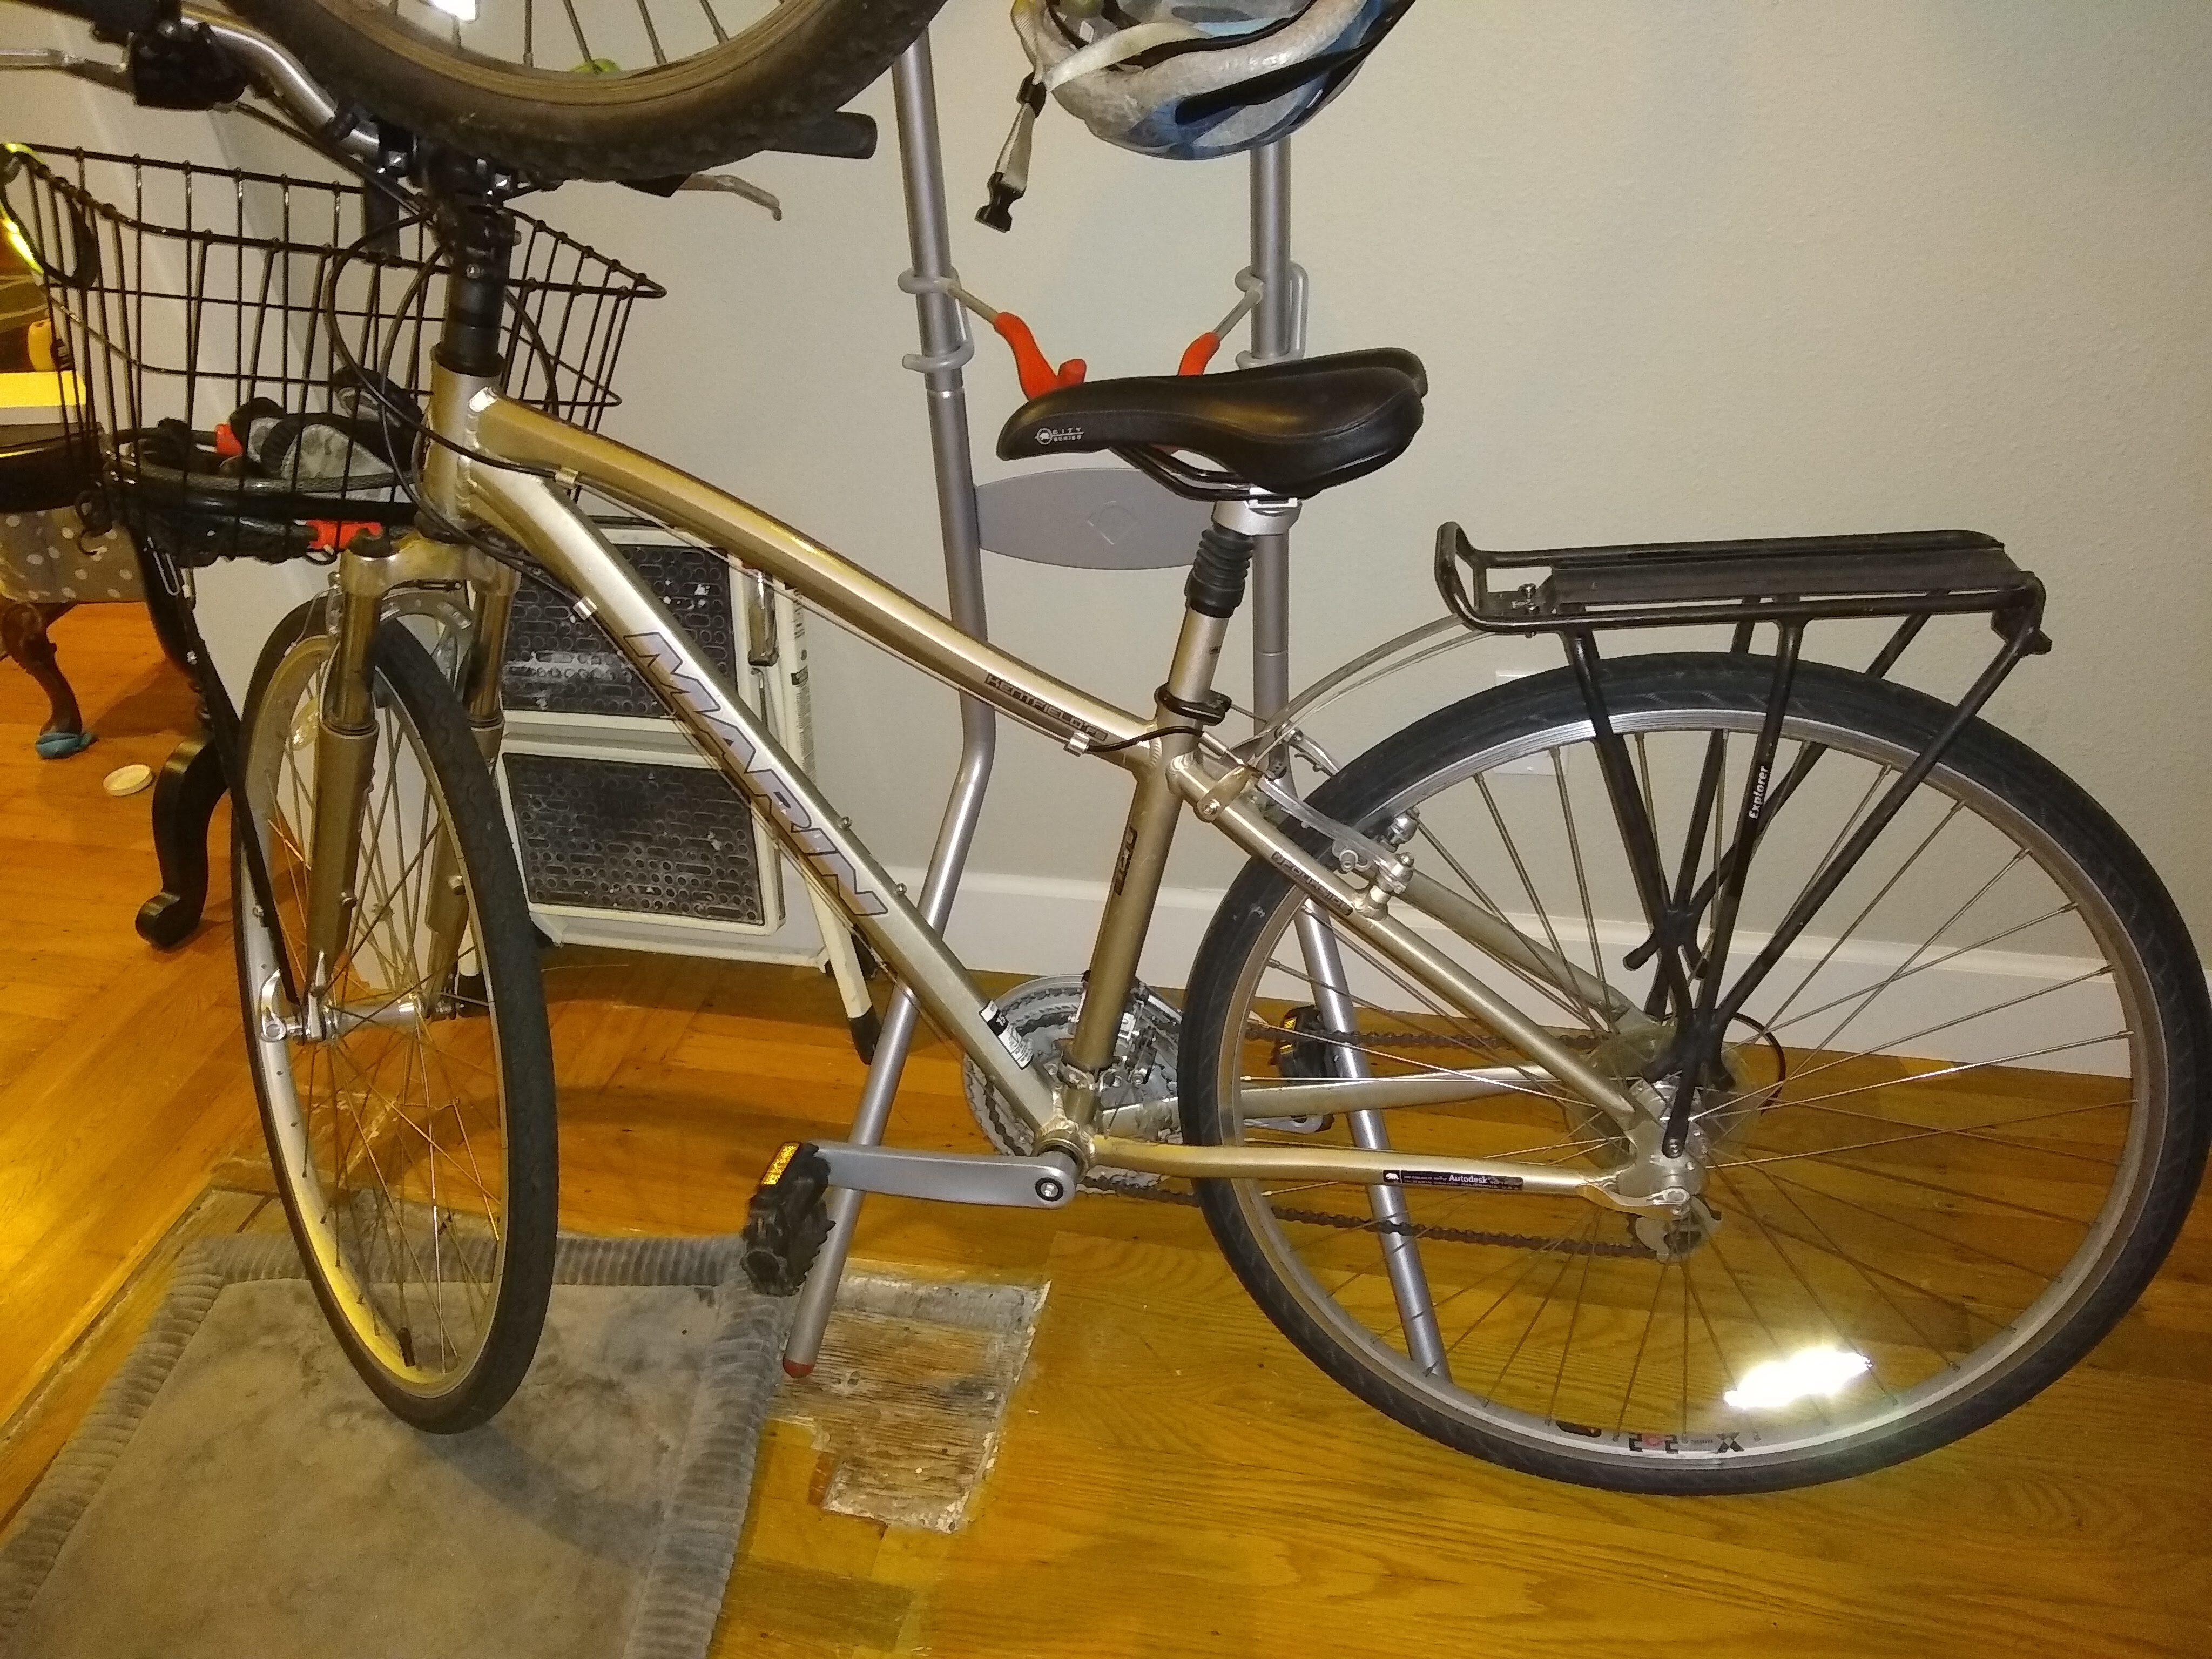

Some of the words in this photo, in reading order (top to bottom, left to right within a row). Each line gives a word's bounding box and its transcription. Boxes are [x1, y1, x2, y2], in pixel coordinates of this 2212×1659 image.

[623, 631, 888, 916] MARIN
[1749, 765, 1769, 819] Explorer
[1449, 1174, 1488, 1184] Autodesk
